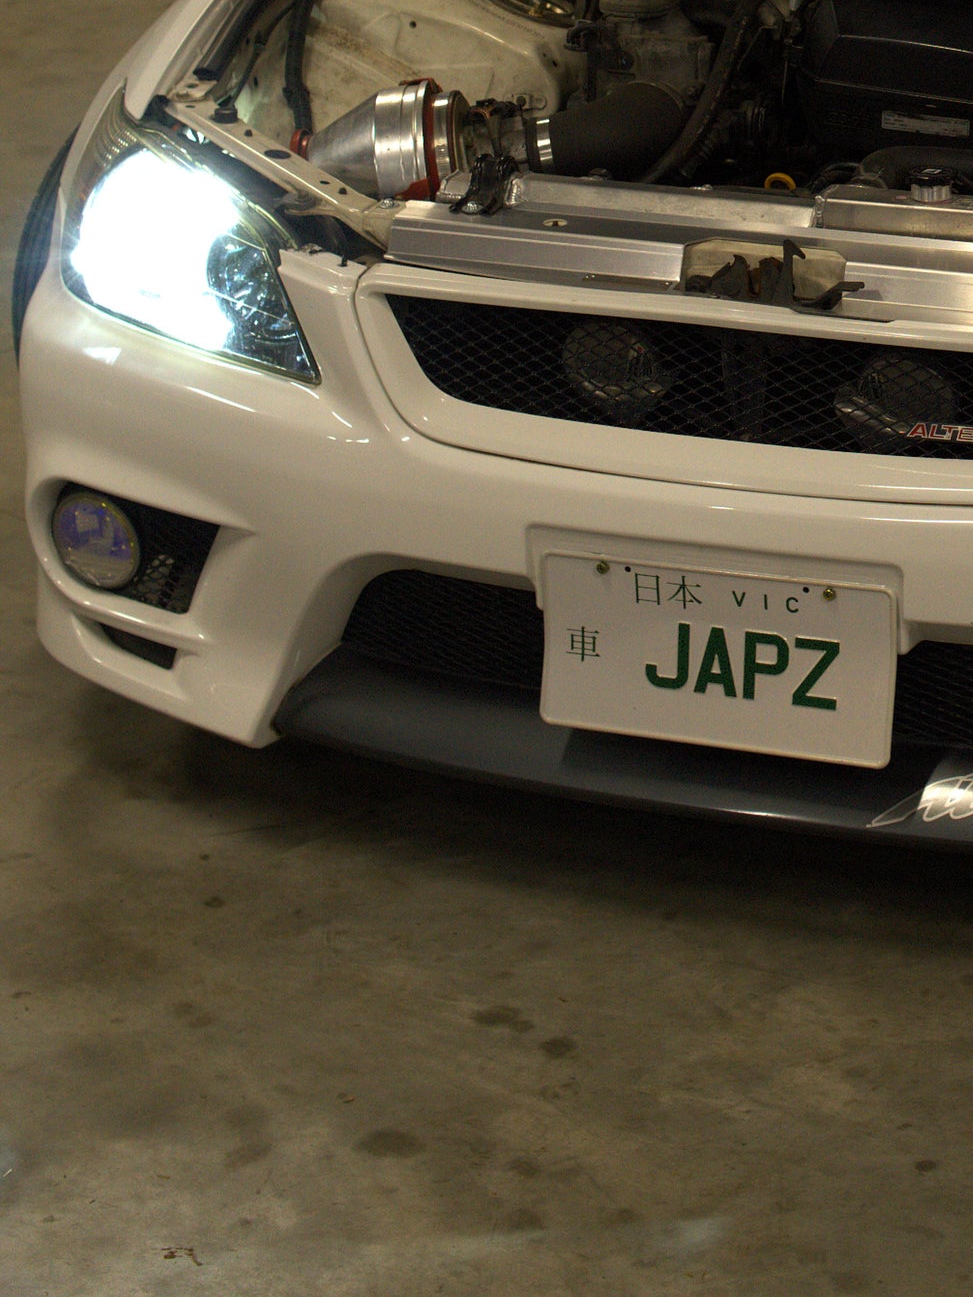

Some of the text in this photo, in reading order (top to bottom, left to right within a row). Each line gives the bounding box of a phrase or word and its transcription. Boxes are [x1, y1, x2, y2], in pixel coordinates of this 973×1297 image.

[635, 573, 702, 609] 日本
[566, 626, 601, 662] 車
[645, 622, 841, 711] JAPZ
